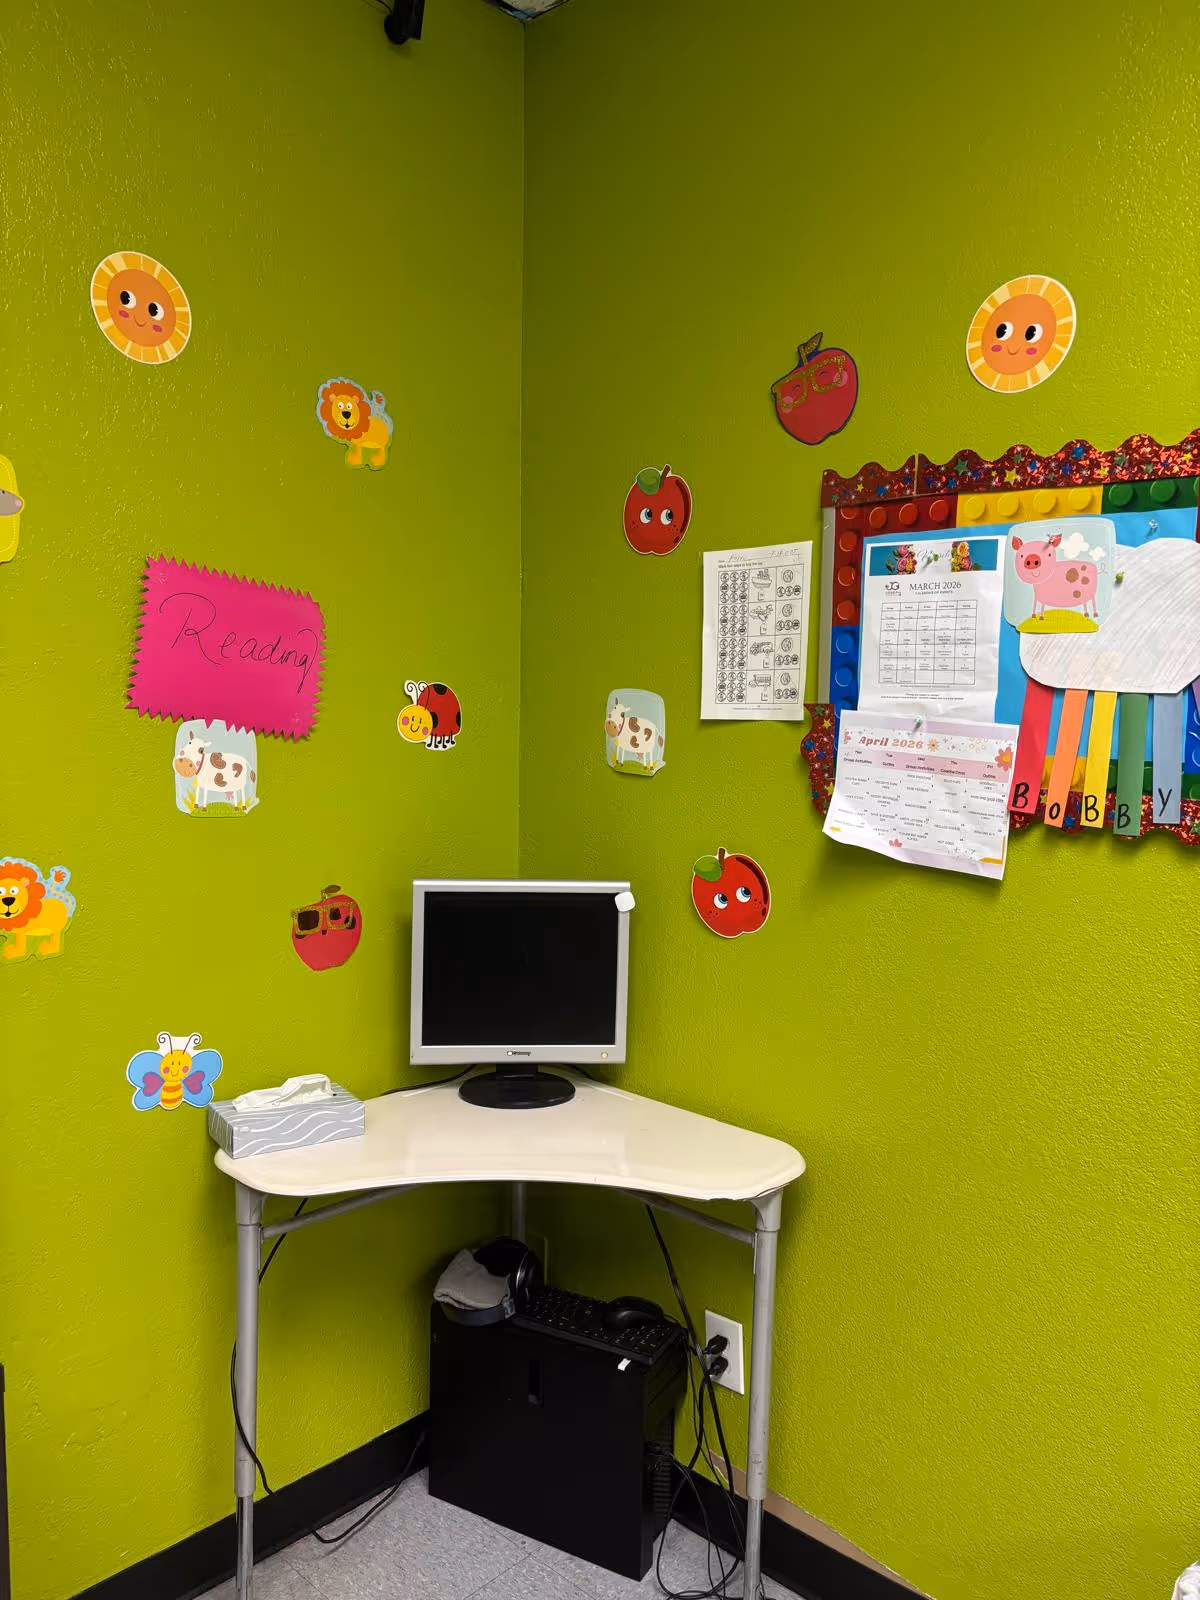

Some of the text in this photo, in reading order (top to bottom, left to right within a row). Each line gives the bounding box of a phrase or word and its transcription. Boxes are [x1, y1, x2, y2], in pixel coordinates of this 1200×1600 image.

[909, 581, 962, 591] MARCH 2026
[159, 592, 319, 694] Reading
[858, 736, 924, 750] April 2026
